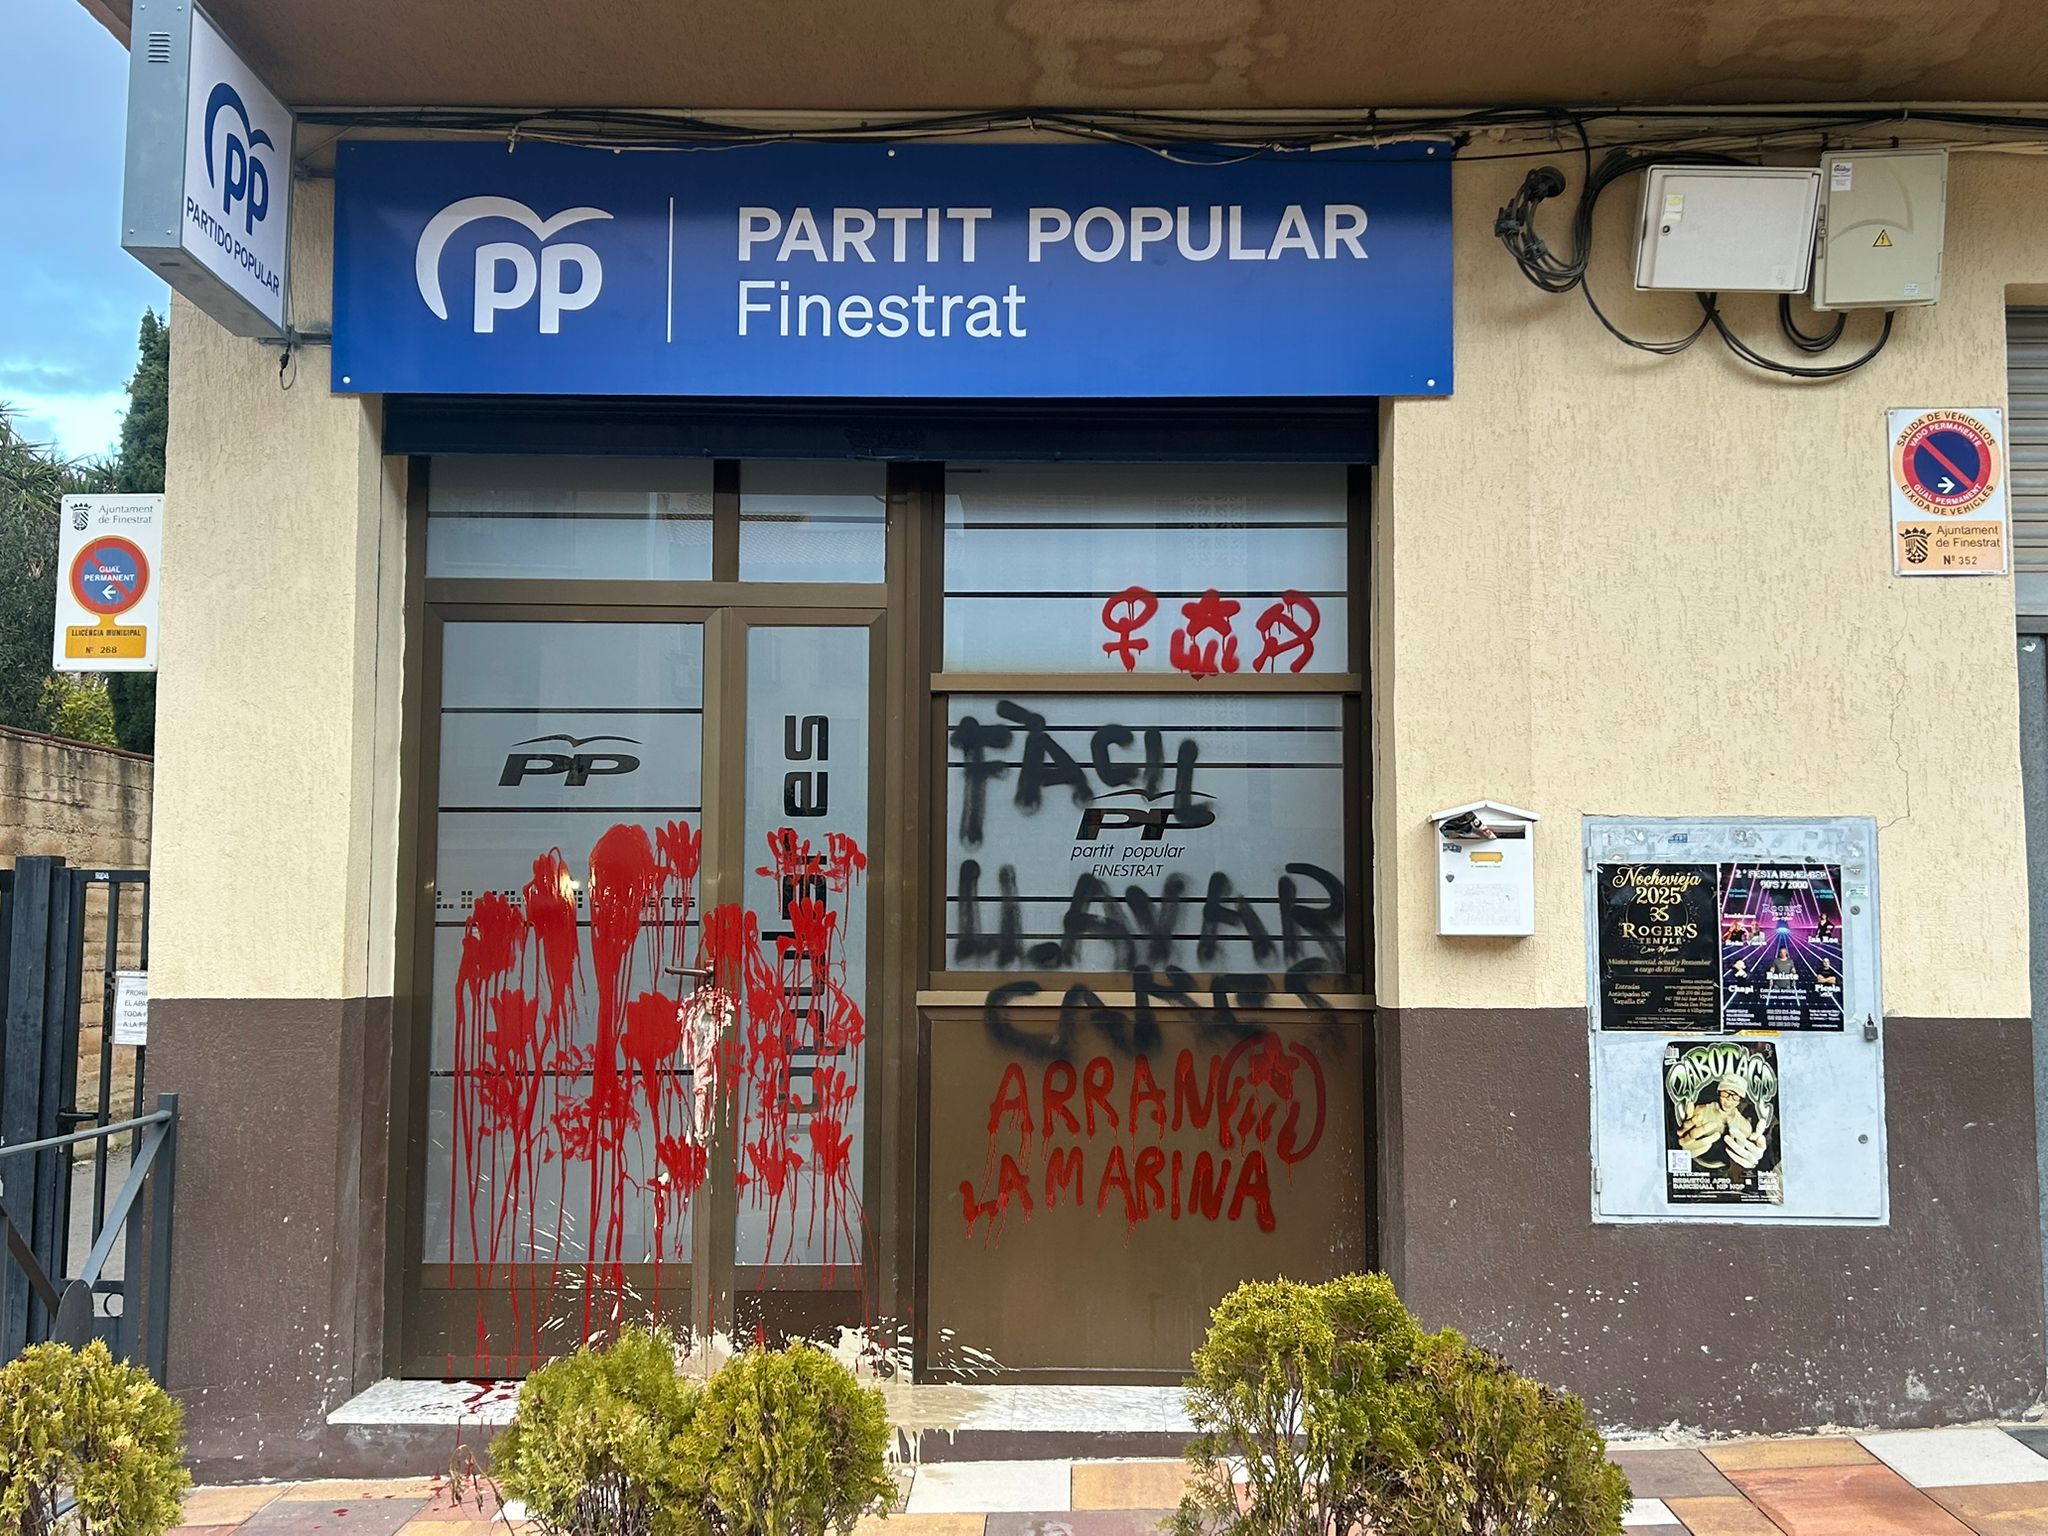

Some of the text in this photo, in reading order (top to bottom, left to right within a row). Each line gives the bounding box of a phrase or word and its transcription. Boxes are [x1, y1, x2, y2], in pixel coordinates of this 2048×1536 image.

[737, 204, 1369, 264] PARTIT POPULAR
[186, 196, 280, 297] PARTIDO POPULAR
[737, 280, 1027, 338] Finestrat
[1896, 418, 1927, 447] SALIDA
[1927, 411, 1940, 421] DE
[1909, 422, 1982, 448] VADO PERMANENTE
[1901, 483, 1994, 516] EIXIDA DE VEHICLES
[1914, 483, 1982, 505] GUAL PERMANENT
[98, 504, 153, 516] Ajuntament
[98, 514, 152, 524] de Finestrat
[1936, 525, 1999, 537] Ajuntament
[1936, 537, 2000, 548] de Finestrat
[1958, 555, 1977, 565] 352
[99, 565, 121, 573] GUAL
[84, 573, 135, 582] PERMANENT
[106, 629, 141, 637] MUNICIPAL
[100, 646, 117, 654] 268
[1070, 843, 1186, 862] partit popular
[1091, 864, 1164, 877] FINESTRAT
[1748, 870, 1779, 879] FIESTA
[1780, 870, 1826, 880] REMEMBER
[1612, 866, 1702, 892] Nochevieja
[1787, 881, 1808, 889] 2000
[1636, 886, 1681, 905] 2025
[1620, 922, 1698, 939] ROGER'S
[1639, 937, 1682, 945] TEMPLE
[1728, 985, 1754, 994] Chapi
[123, 1010, 143, 1018] TODA
[1046, 1145, 1277, 1234] MARINA
